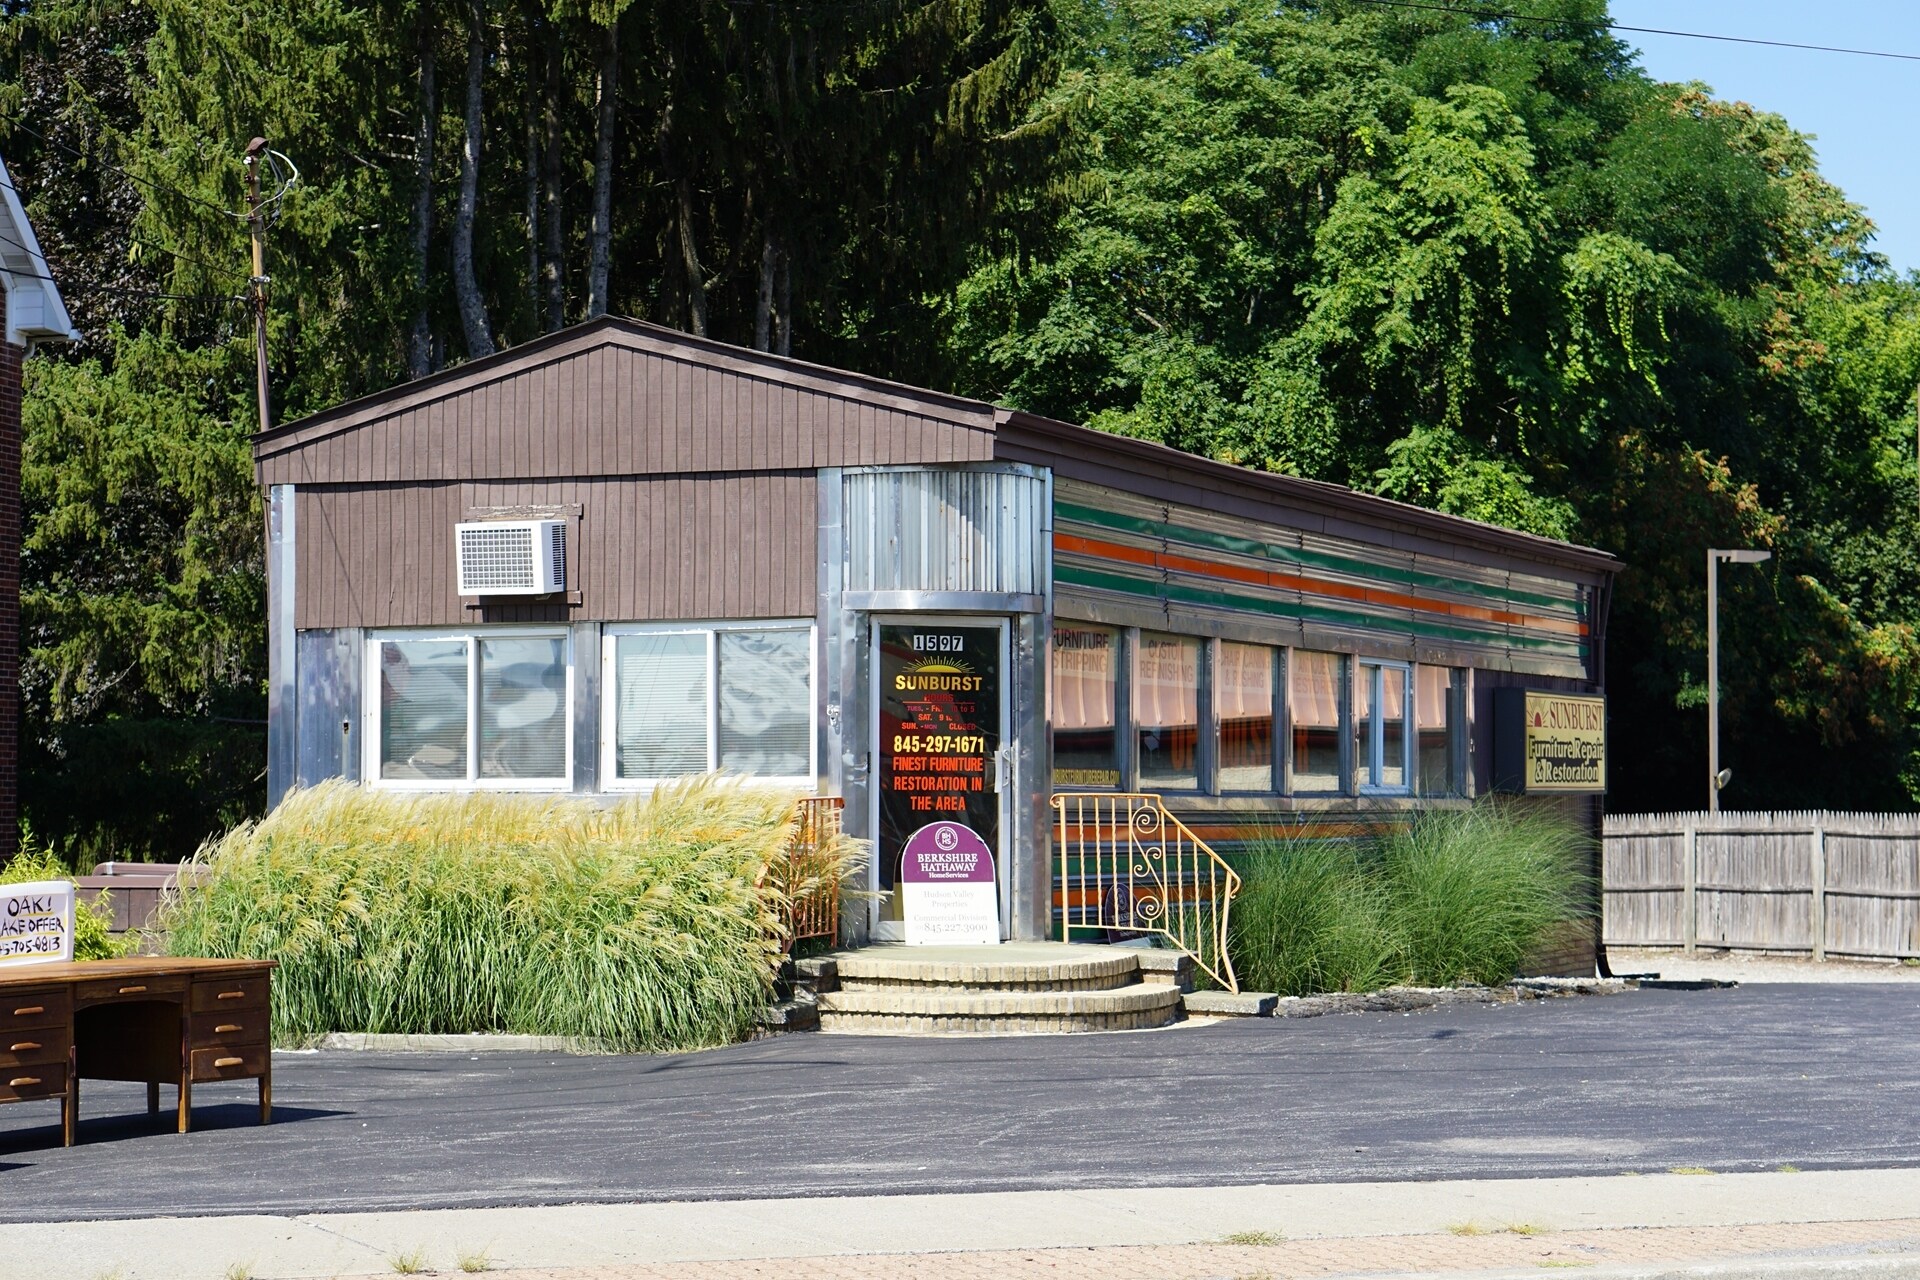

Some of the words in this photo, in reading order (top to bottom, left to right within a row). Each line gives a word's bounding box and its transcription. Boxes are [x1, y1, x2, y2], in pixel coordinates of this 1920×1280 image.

[914, 635, 963, 651] 1597
[1053, 628, 1109, 651] FURNITURE
[1053, 651, 1107, 673] STRIPPING
[1140, 660, 1193, 683] REFNISHNG
[895, 675, 982, 691] SUNBURST
[1550, 701, 1603, 731] SUNBURST
[893, 735, 984, 753] 845-297-1671
[1528, 734, 1574, 760] Furniture
[1574, 737, 1603, 764] Repair
[893, 756, 927, 771] FINEST
[929, 757, 983, 772] FURNITURE
[1535, 760, 1544, 783] &
[1545, 760, 1599, 783] Restoration
[893, 776, 967, 791] RESTORATION
[971, 777, 982, 791] IN
[910, 795, 932, 811] THE
[935, 796, 966, 811] AREA
[917, 853, 978, 862] BERKSHIRE
[921, 862, 976, 871] HATHAWAY
[923, 890, 951, 898] Hudson
[953, 890, 974, 900] Valley
[931, 900, 968, 909] Properties
[0, 918, 25, 937] AKE
[28, 917, 65, 933] OFFER
[924, 922, 988, 933] 845.227.3900
